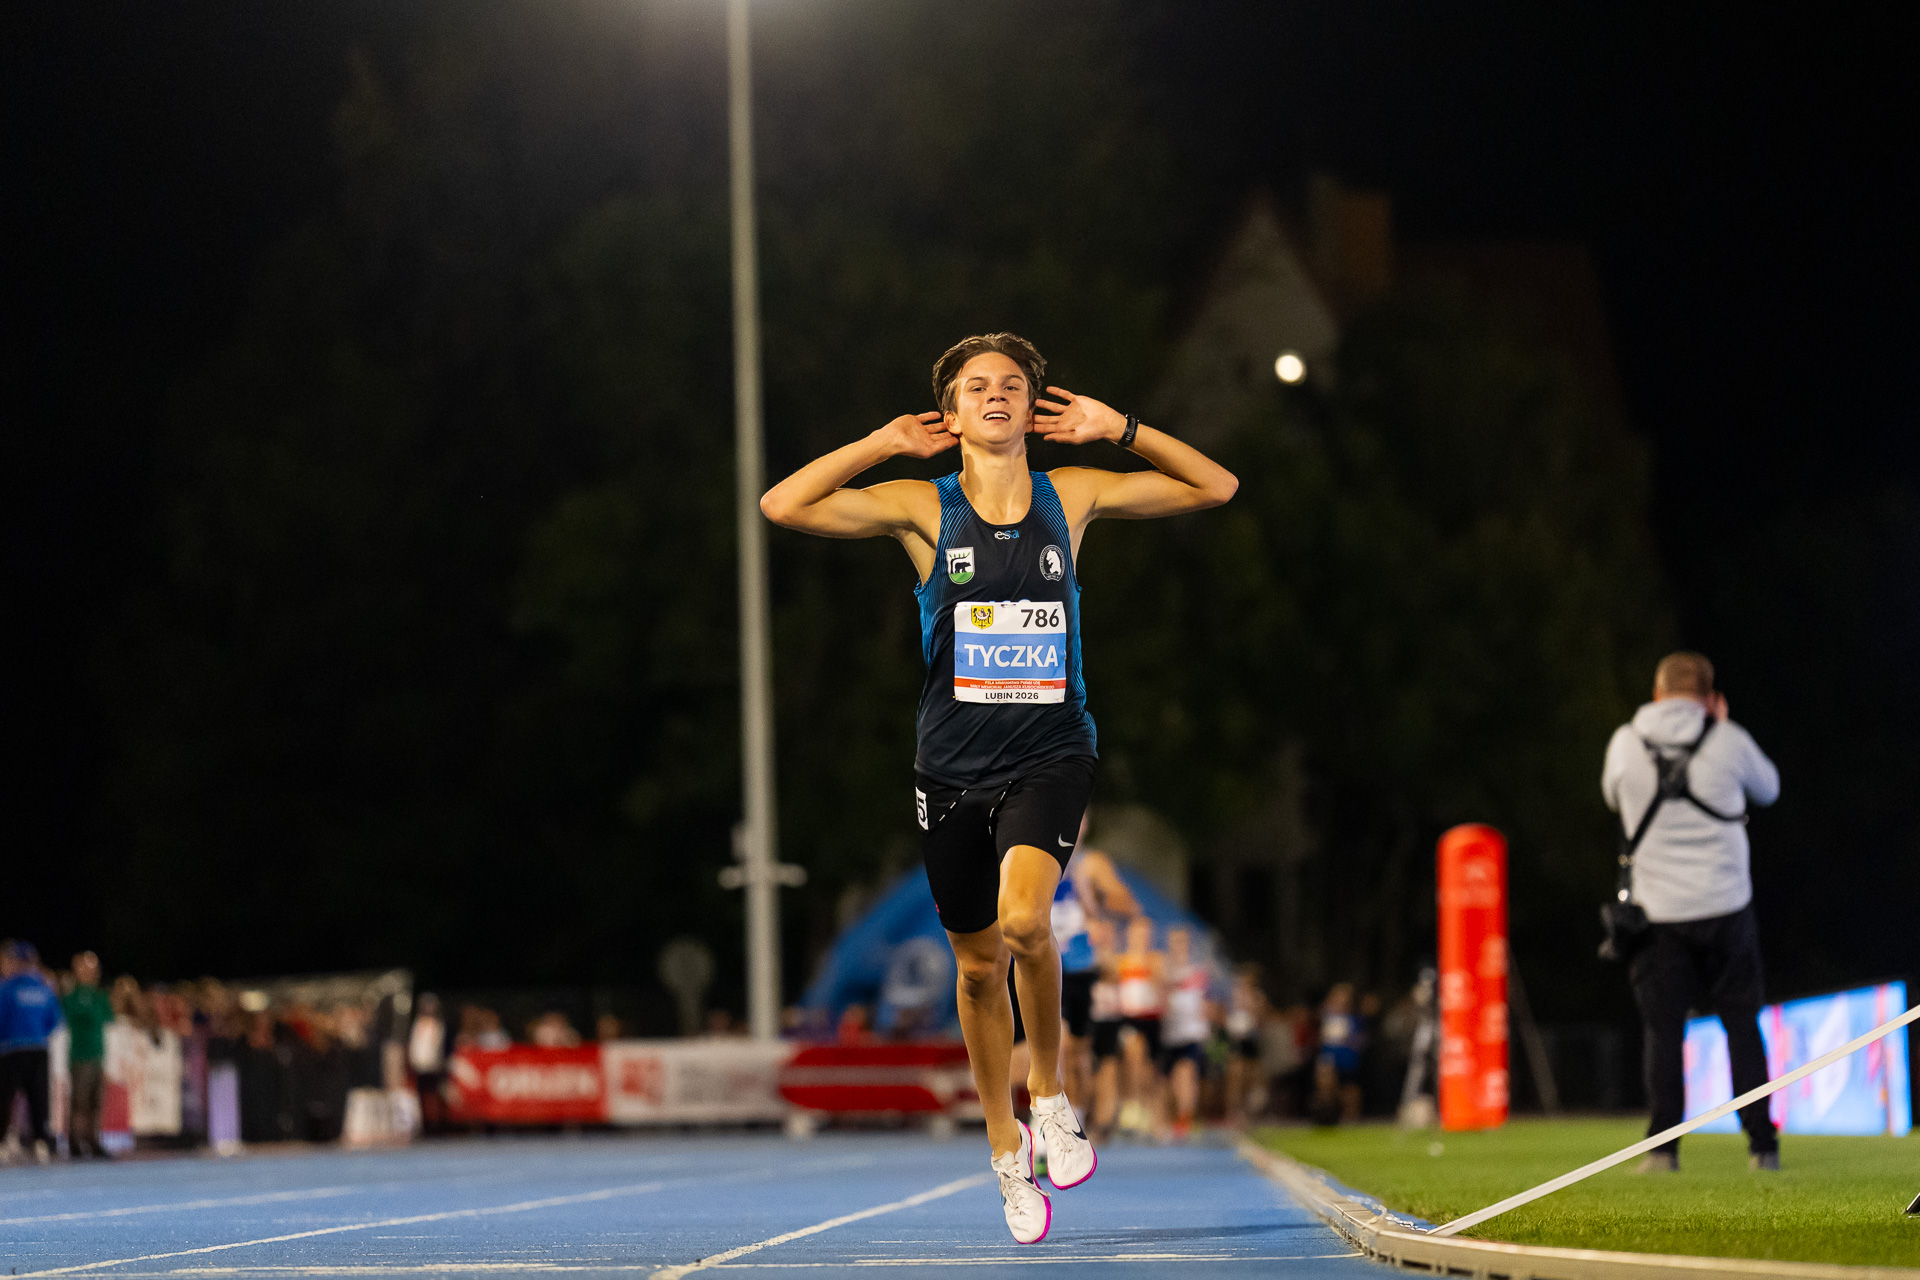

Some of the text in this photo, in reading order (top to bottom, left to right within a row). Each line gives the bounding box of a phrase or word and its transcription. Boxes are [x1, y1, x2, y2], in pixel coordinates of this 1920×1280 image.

[994, 530, 1019, 540] esa
[1021, 608, 1060, 628] 786
[964, 644, 1059, 668] TYCZKA
[985, 691, 1039, 700] LUBIN 2026
